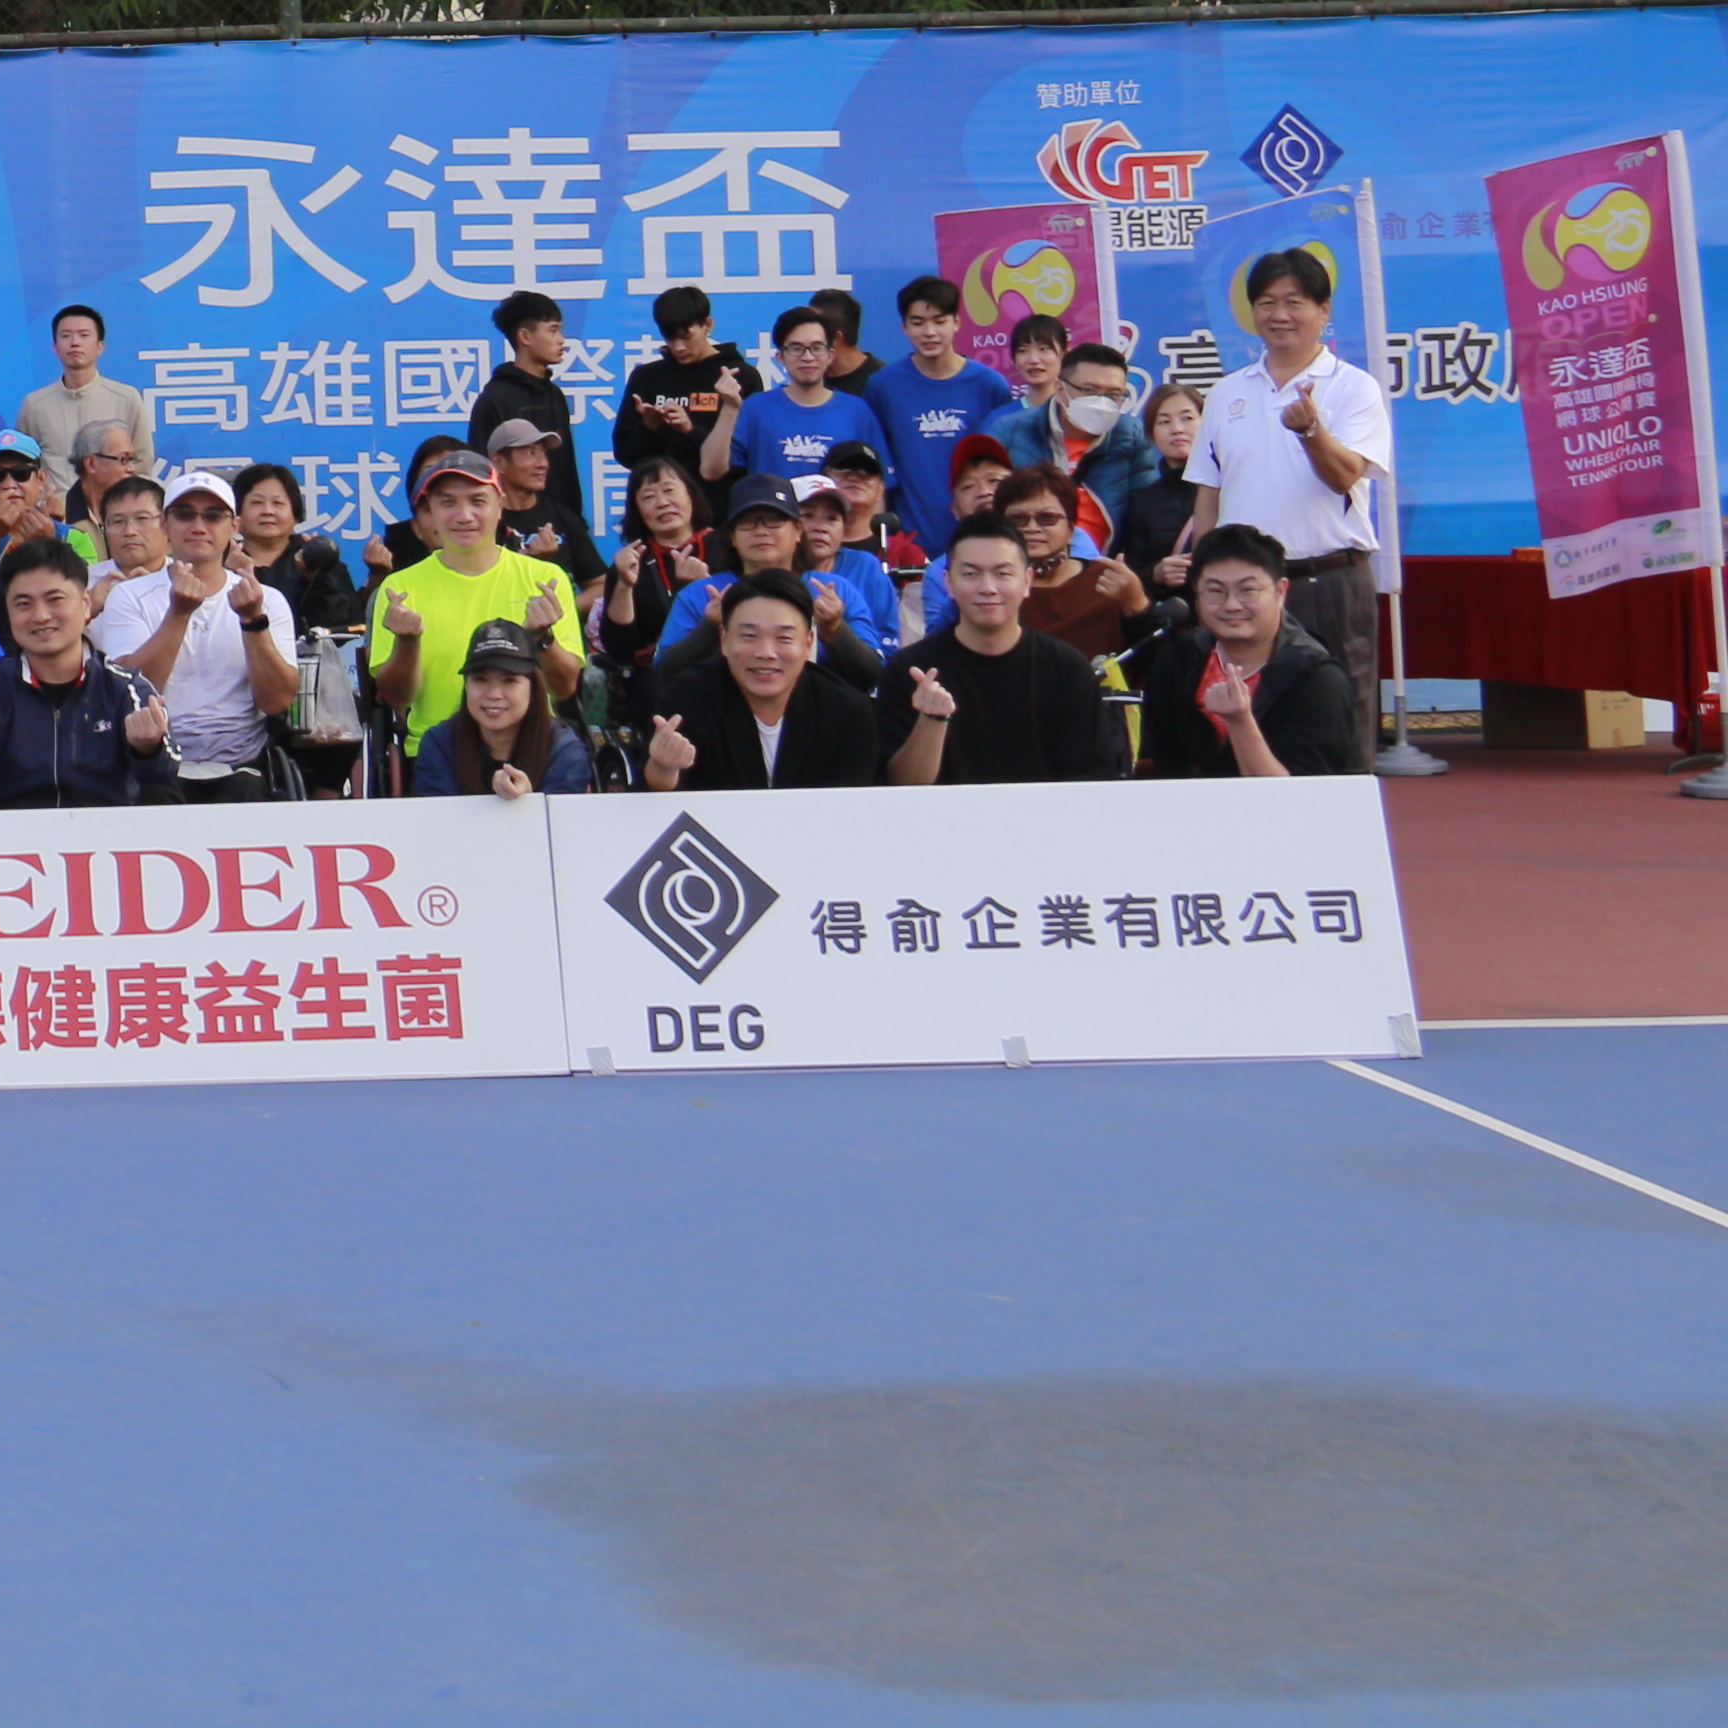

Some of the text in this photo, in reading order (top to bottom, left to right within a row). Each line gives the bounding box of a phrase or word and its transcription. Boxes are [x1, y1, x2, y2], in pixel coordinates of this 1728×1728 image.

[140, 127, 853, 307] 永達盃
[1537, 276, 1648, 316] KAO HSIUNG
[1541, 295, 1649, 340] OPEN
[973, 332, 1008, 349] KAO
[1549, 337, 1652, 387] 永達盃
[1563, 415, 1663, 456] UNIQLO
[1564, 438, 1662, 472] WHEELCHAIR
[808, 888, 1365, 956] 得俞企業有限公司
[646, 1003, 766, 1053] DEG
